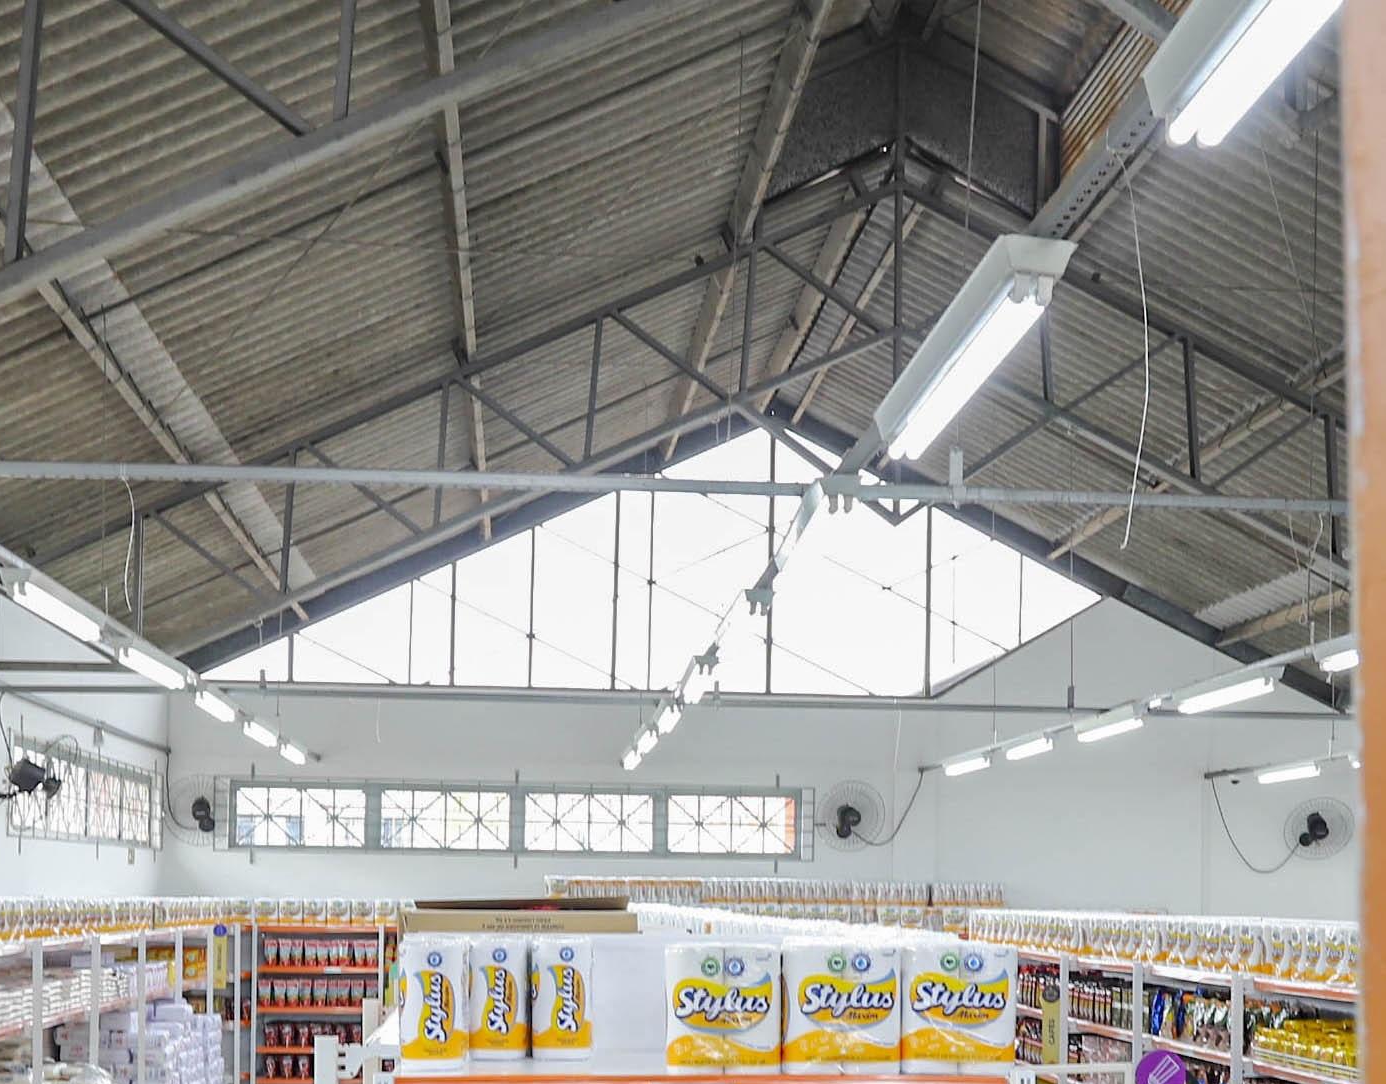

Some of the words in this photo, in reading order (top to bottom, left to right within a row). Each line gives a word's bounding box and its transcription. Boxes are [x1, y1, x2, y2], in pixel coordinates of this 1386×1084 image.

[424, 973, 447, 1043] Stylus
[486, 966, 508, 1034] Stylus
[555, 965, 578, 1033] Stylus
[675, 985, 769, 1022] Stylus
[800, 981, 895, 1019] Stylus
[913, 980, 1006, 1018] Stylus
